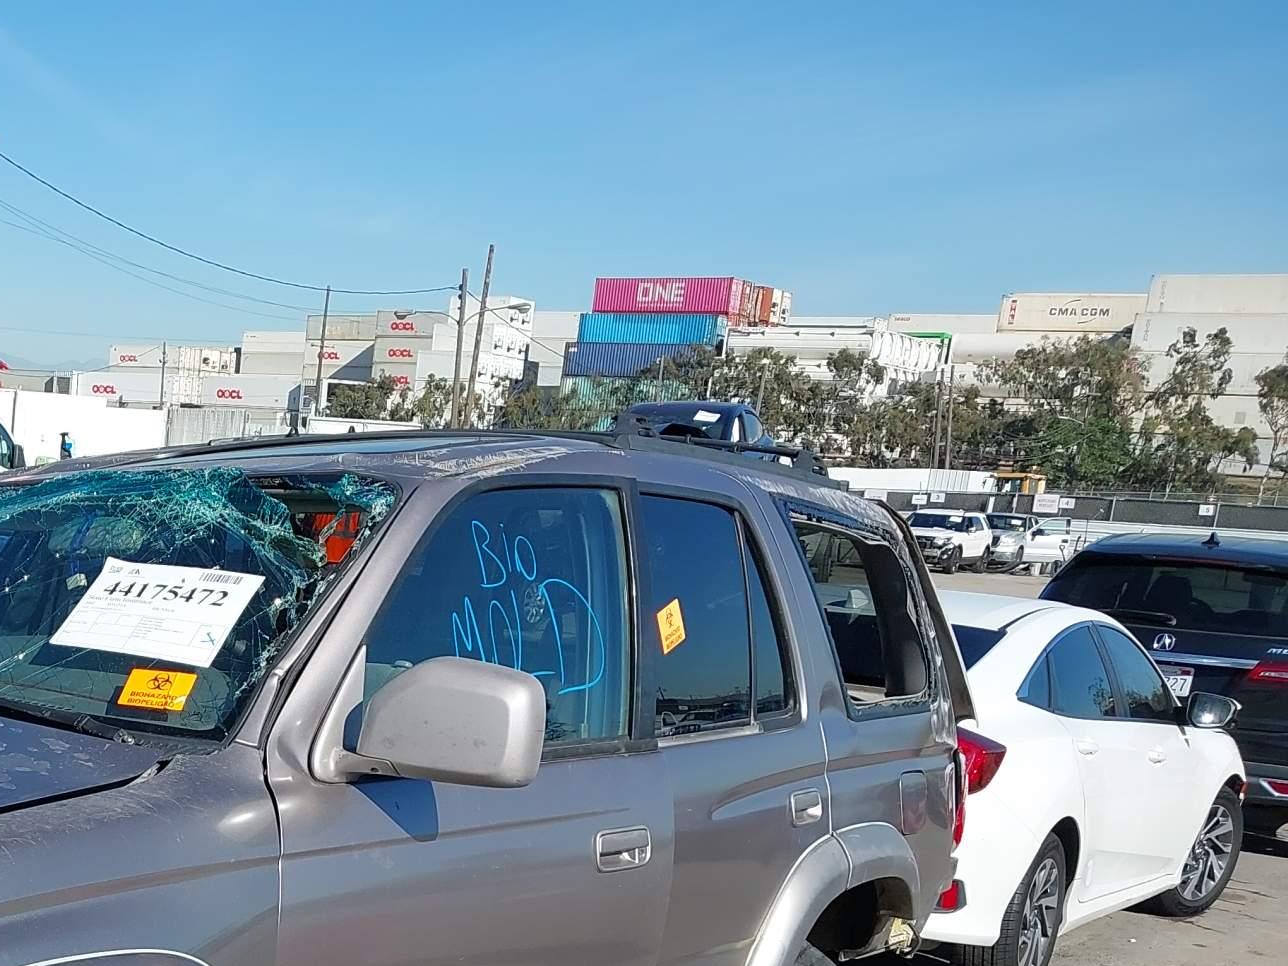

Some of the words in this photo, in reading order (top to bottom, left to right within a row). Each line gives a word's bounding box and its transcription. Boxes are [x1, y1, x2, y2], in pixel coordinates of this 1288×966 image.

[637, 282, 685, 301] ONE
[1049, 308, 1077, 316] CMA
[1081, 308, 1110, 316] CGM
[390, 322, 414, 331] OOCL
[387, 349, 413, 357] OOCL
[92, 385, 116, 394] OOCL
[216, 390, 242, 399] OOCL
[104, 580, 229, 607] 44175472
[130, 690, 177, 701] BIOHAZARD
